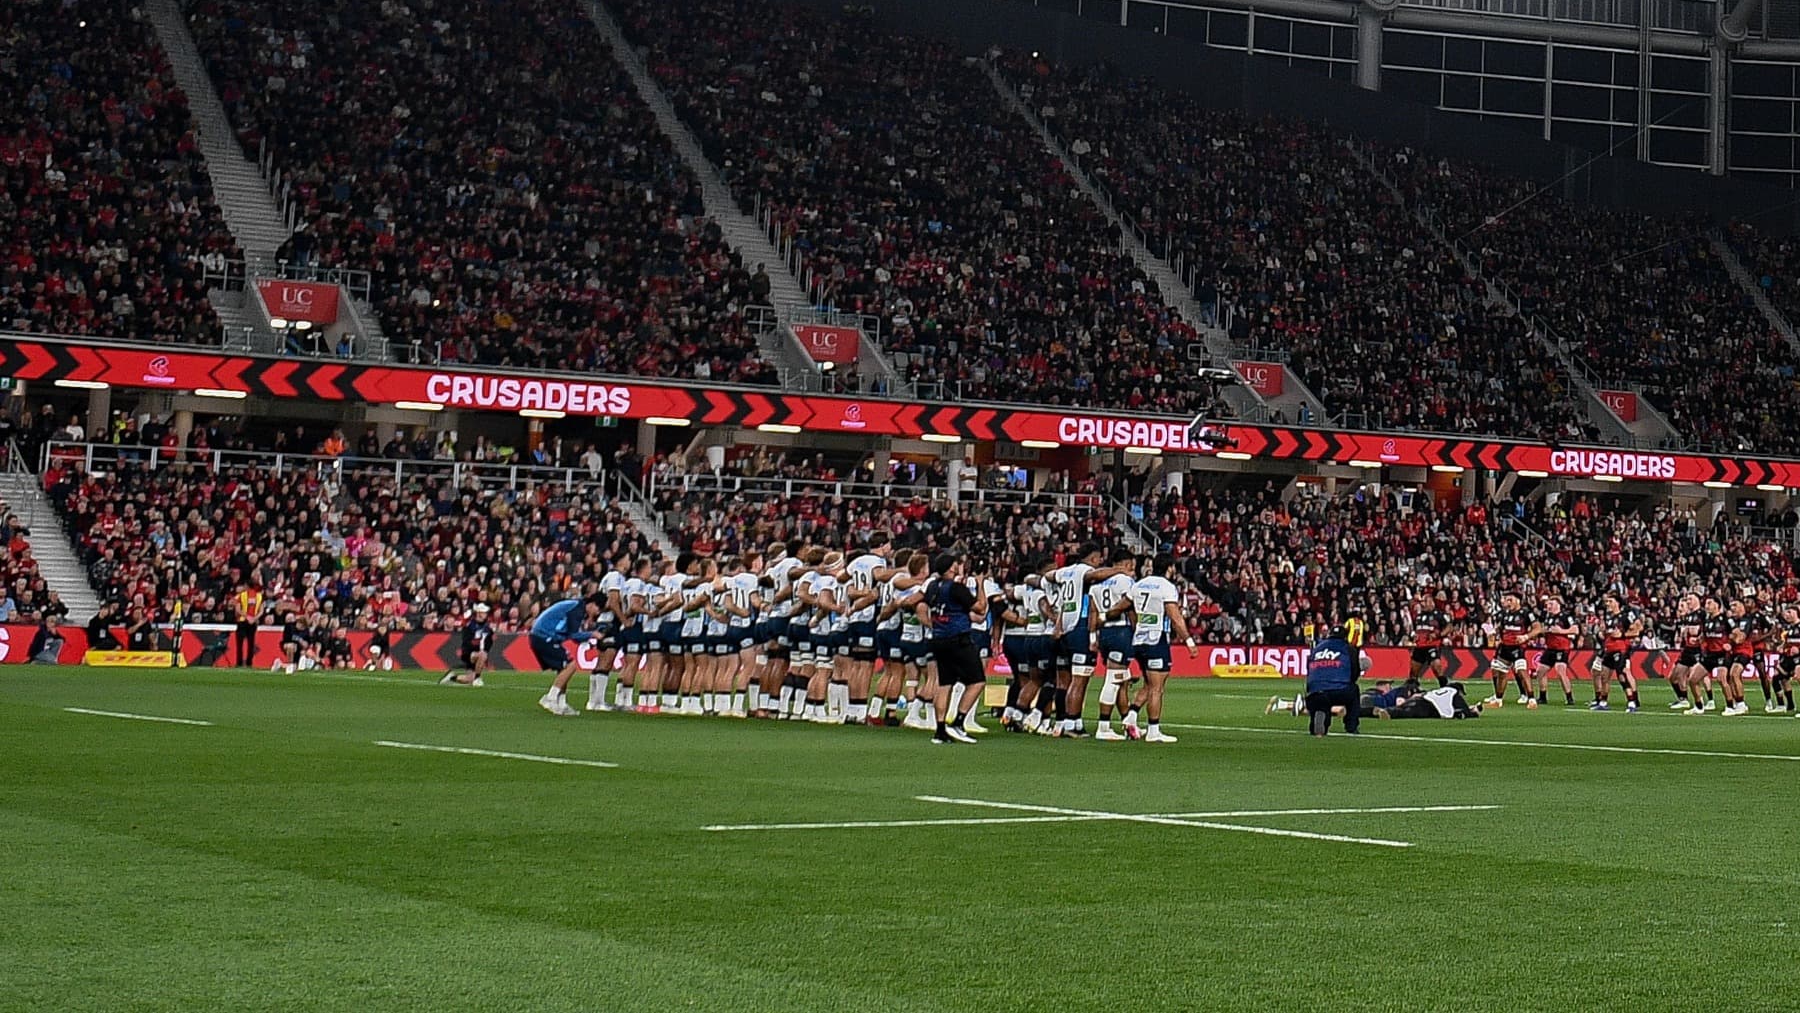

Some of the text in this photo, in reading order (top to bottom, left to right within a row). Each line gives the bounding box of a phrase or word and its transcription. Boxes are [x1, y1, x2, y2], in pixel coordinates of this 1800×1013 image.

[282, 287, 313, 306] UC
[812, 331, 837, 348] UC
[1247, 368, 1268, 382] UC
[426, 374, 631, 414] CRUSADERS
[1607, 396, 1625, 409] UC
[1550, 450, 1676, 478] CRUSADERS
[1102, 588, 1112, 609] 8
[1140, 591, 1150, 612] 7
[1314, 648, 1341, 661] sky
